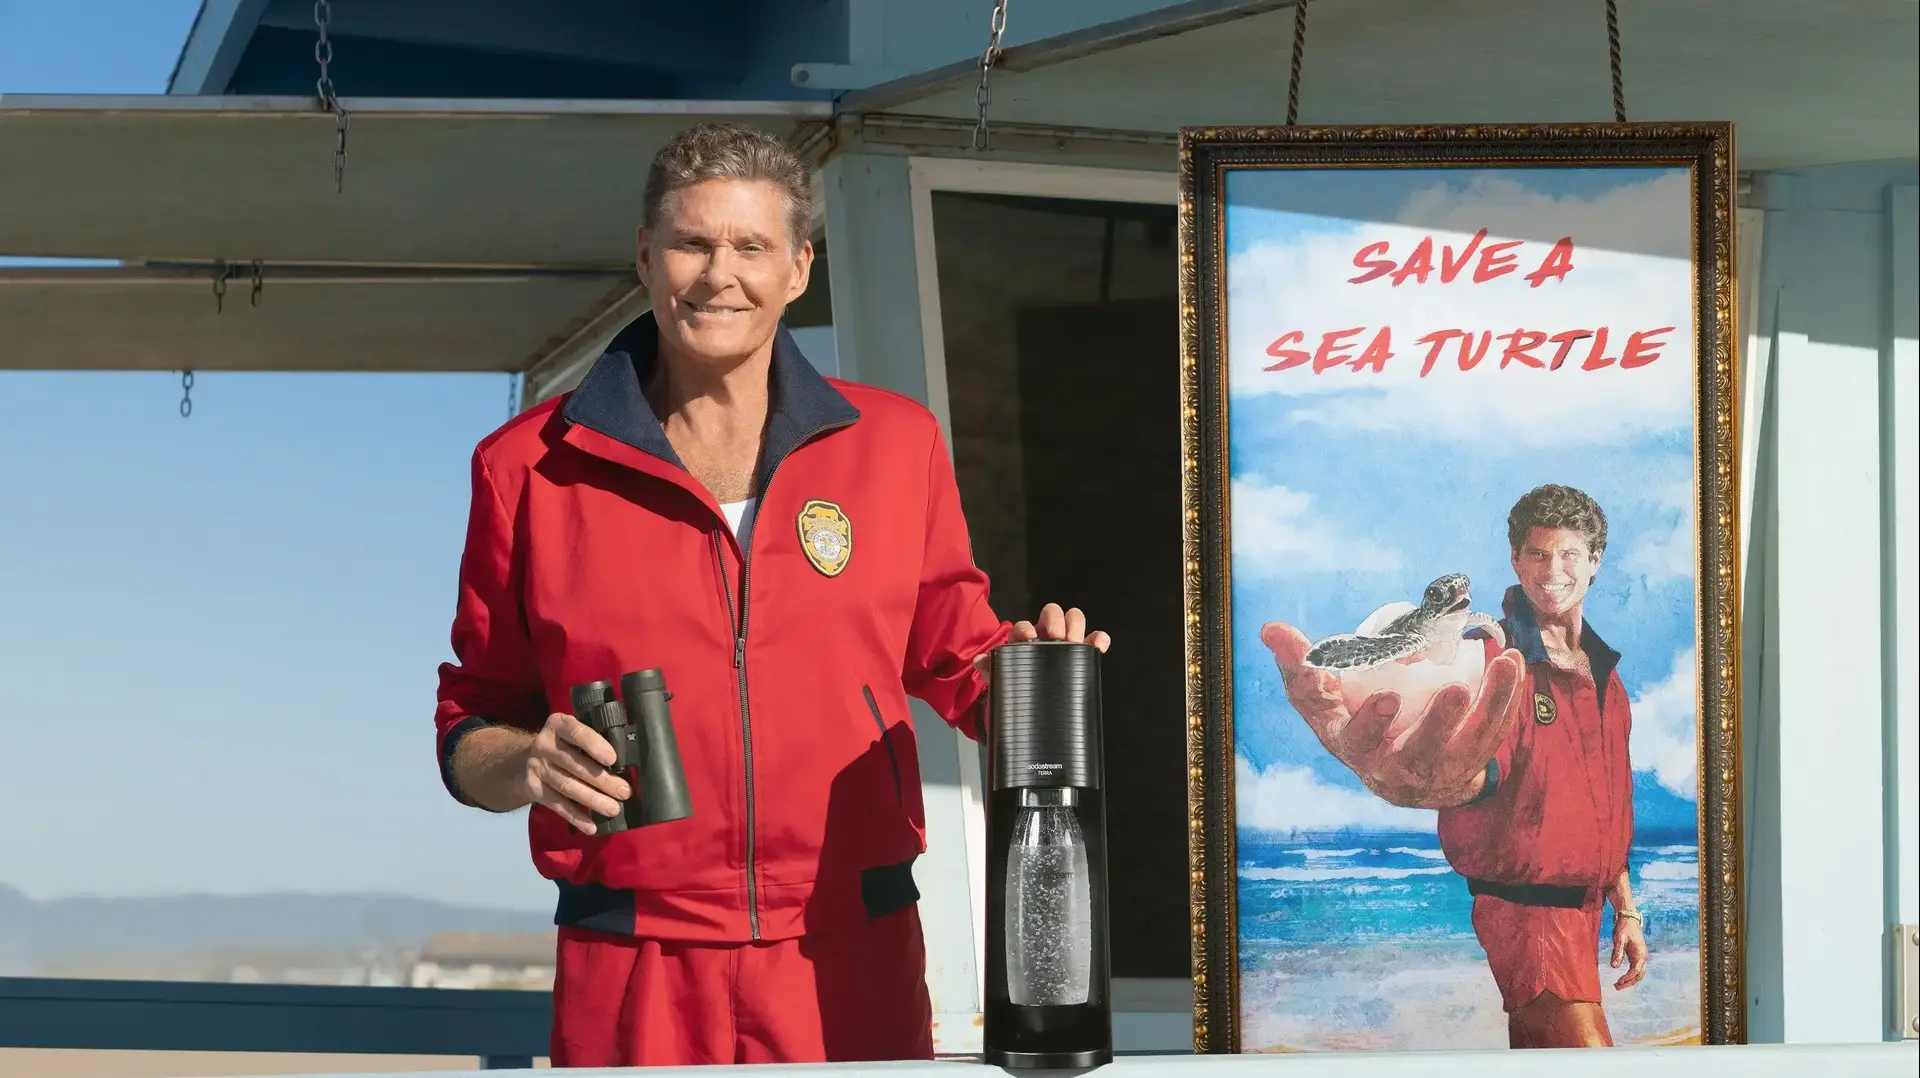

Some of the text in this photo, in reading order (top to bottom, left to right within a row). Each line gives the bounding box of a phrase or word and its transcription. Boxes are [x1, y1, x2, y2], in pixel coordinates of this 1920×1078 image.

[1348, 227, 1575, 288] SAVE A
[1262, 326, 1676, 378] SEA TURTLE
[1027, 762, 1063, 770] sodastream
